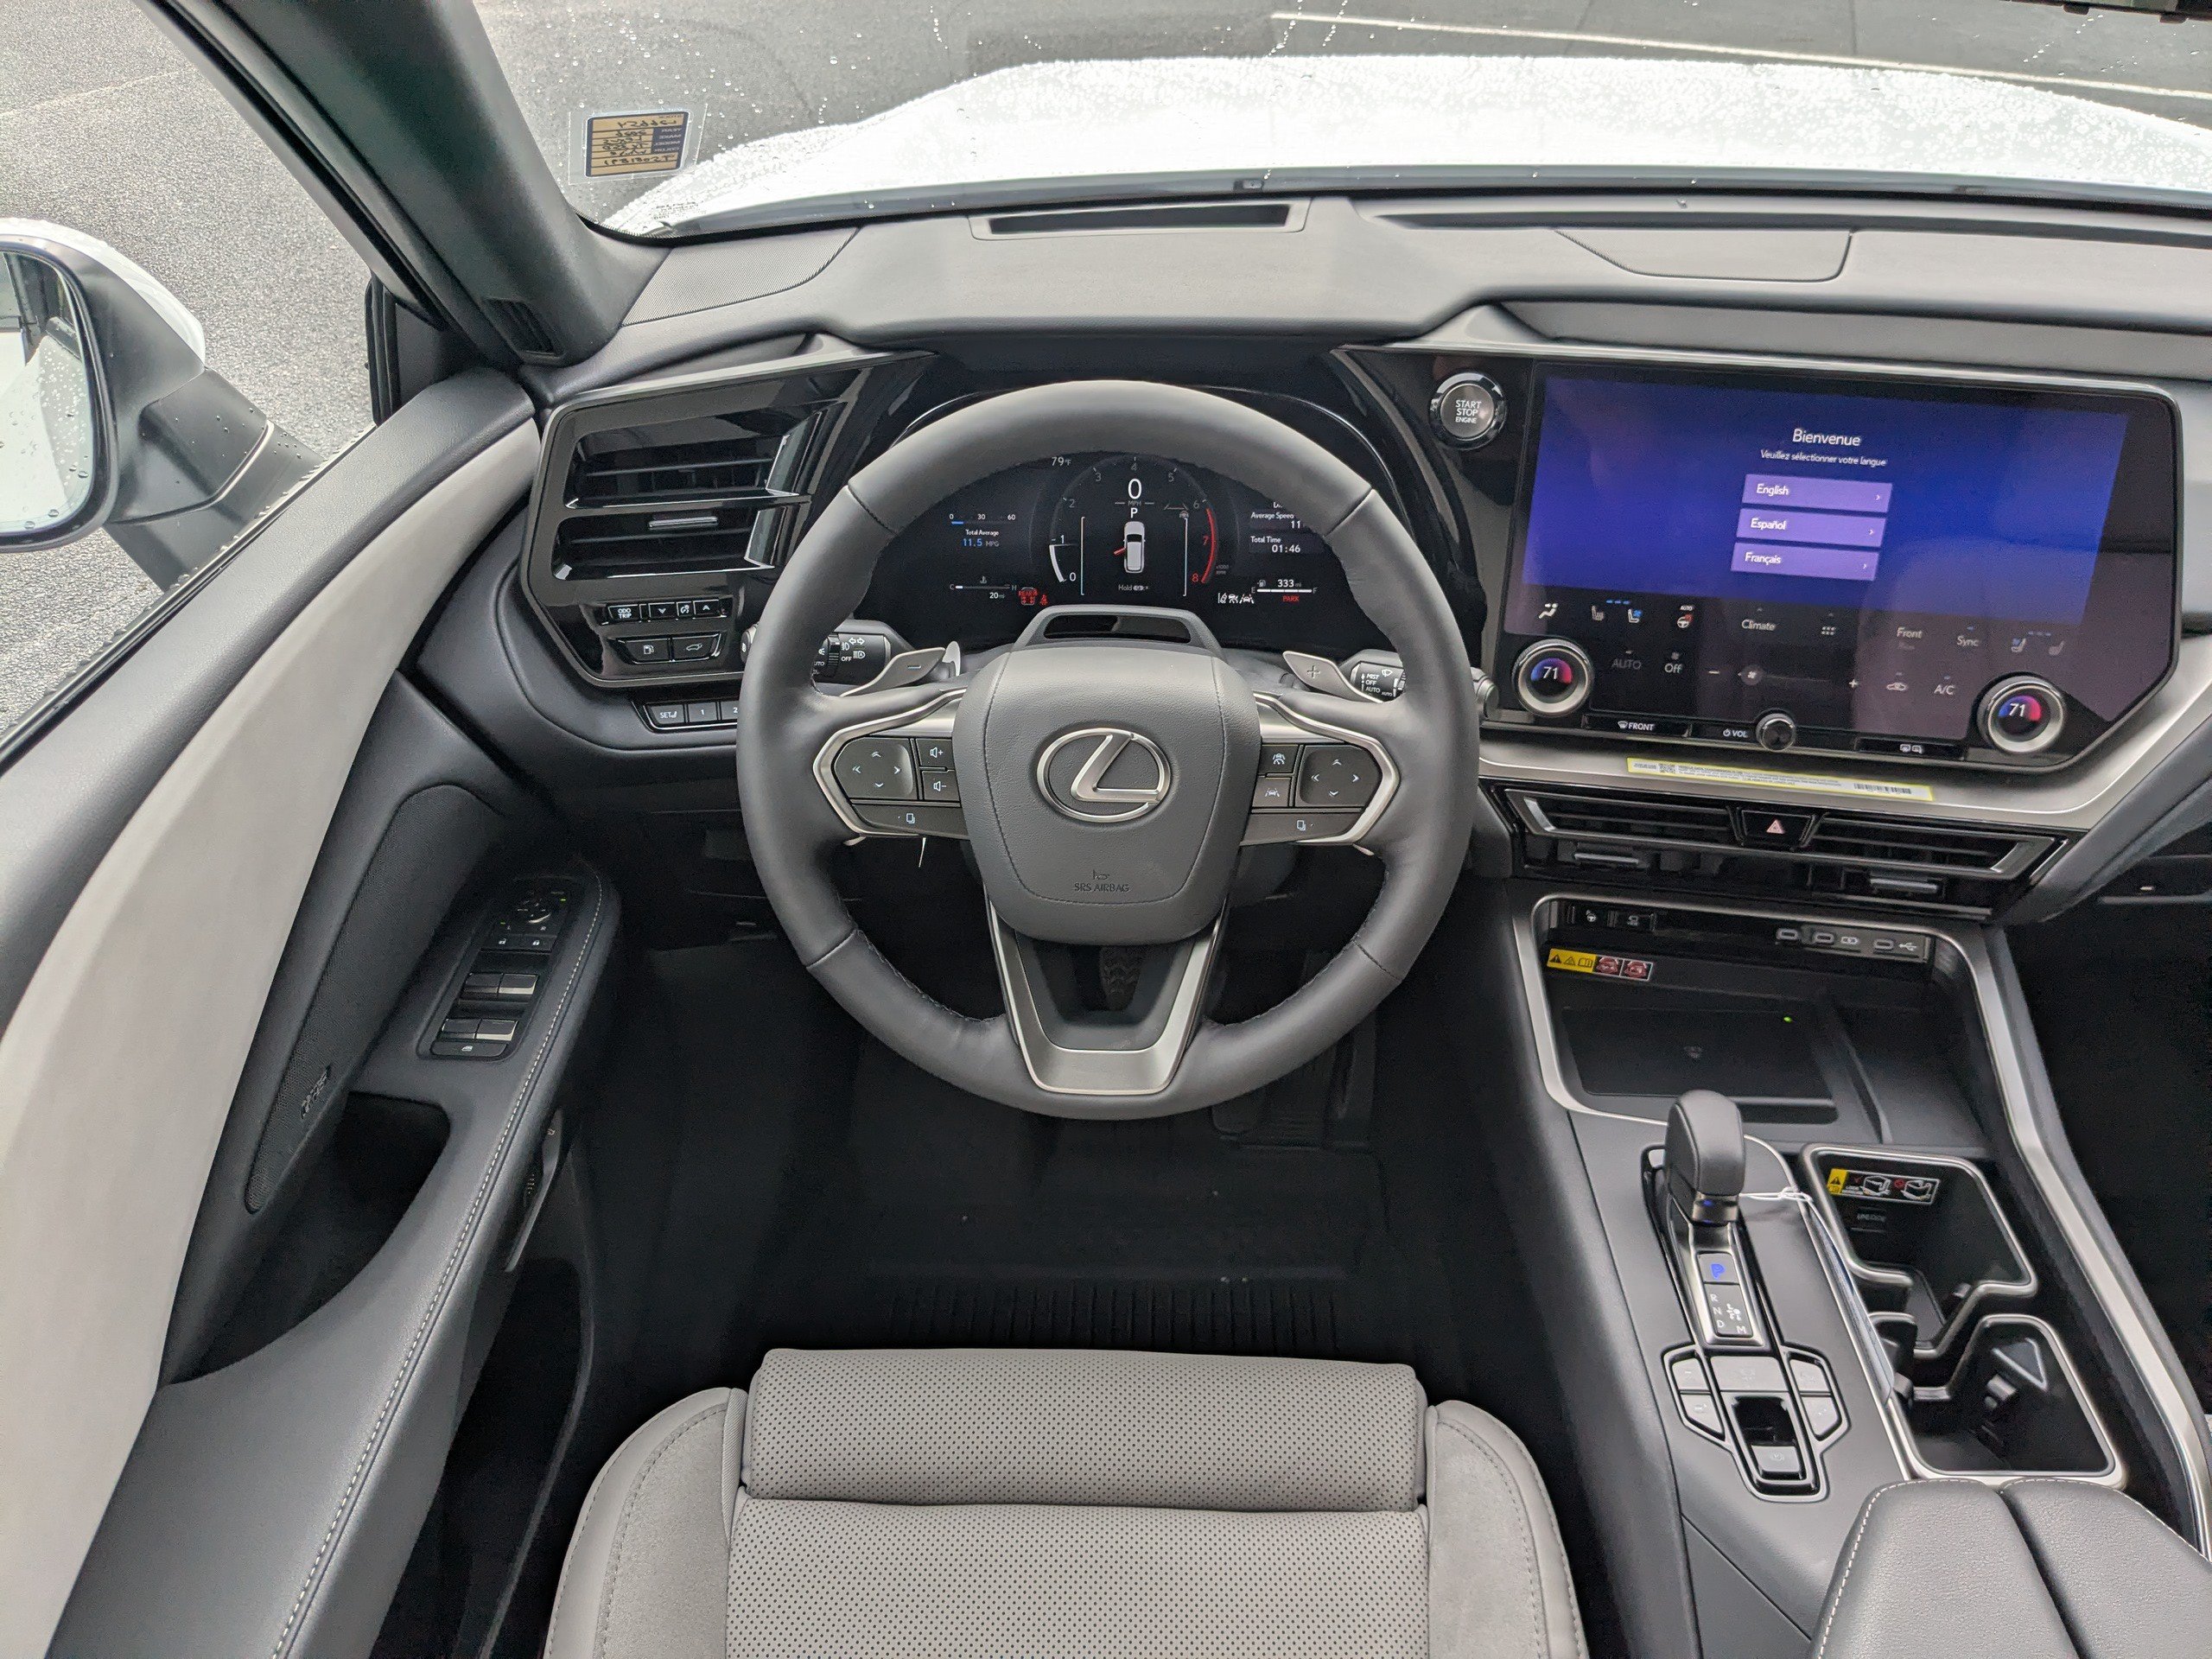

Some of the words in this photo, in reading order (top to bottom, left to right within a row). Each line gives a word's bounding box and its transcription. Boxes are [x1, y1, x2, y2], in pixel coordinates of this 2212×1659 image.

[1455, 399, 1482, 409] START
[1456, 408, 1478, 416] STOP
[1792, 428, 1861, 446] Bienvenue
[1760, 449, 1789, 461] Veuillez
[1791, 452, 1837, 463] sélectionner
[1859, 456, 1886, 467] langue
[1096, 473, 1102, 482] 3
[1168, 474, 1174, 482] 5
[1128, 478, 1142, 499] 0
[1756, 483, 1789, 497] English
[1069, 499, 1075, 508] 2
[1192, 500, 1199, 509] 6
[1130, 507, 1138, 518] P
[1750, 517, 1786, 531] Español
[963, 538, 982, 547] 11.5
[1060, 535, 1065, 543] 1
[1203, 535, 1209, 545] 7
[1272, 544, 1301, 553] 01:46
[1745, 551, 1781, 565] Français
[1069, 572, 1077, 582] 0
[1192, 573, 1199, 583] 8
[1741, 619, 1777, 632] Climate
[1897, 626, 1923, 639] Front
[1956, 635, 1980, 647] Sync
[1611, 658, 1642, 671] AUTO
[1543, 667, 1559, 680] 71
[1934, 684, 1955, 696] A/C
[2008, 703, 2025, 716] 71
[1628, 722, 1655, 731] FRONT
[1074, 882, 1092, 892] SRS
[1094, 883, 1130, 893] AIRBAG
[1710, 1263, 1726, 1279] P
[1710, 1294, 1718, 1302] R
[1713, 1306, 1722, 1315] N
[1717, 1319, 1725, 1328] D
[1736, 1325, 1745, 1334] M
